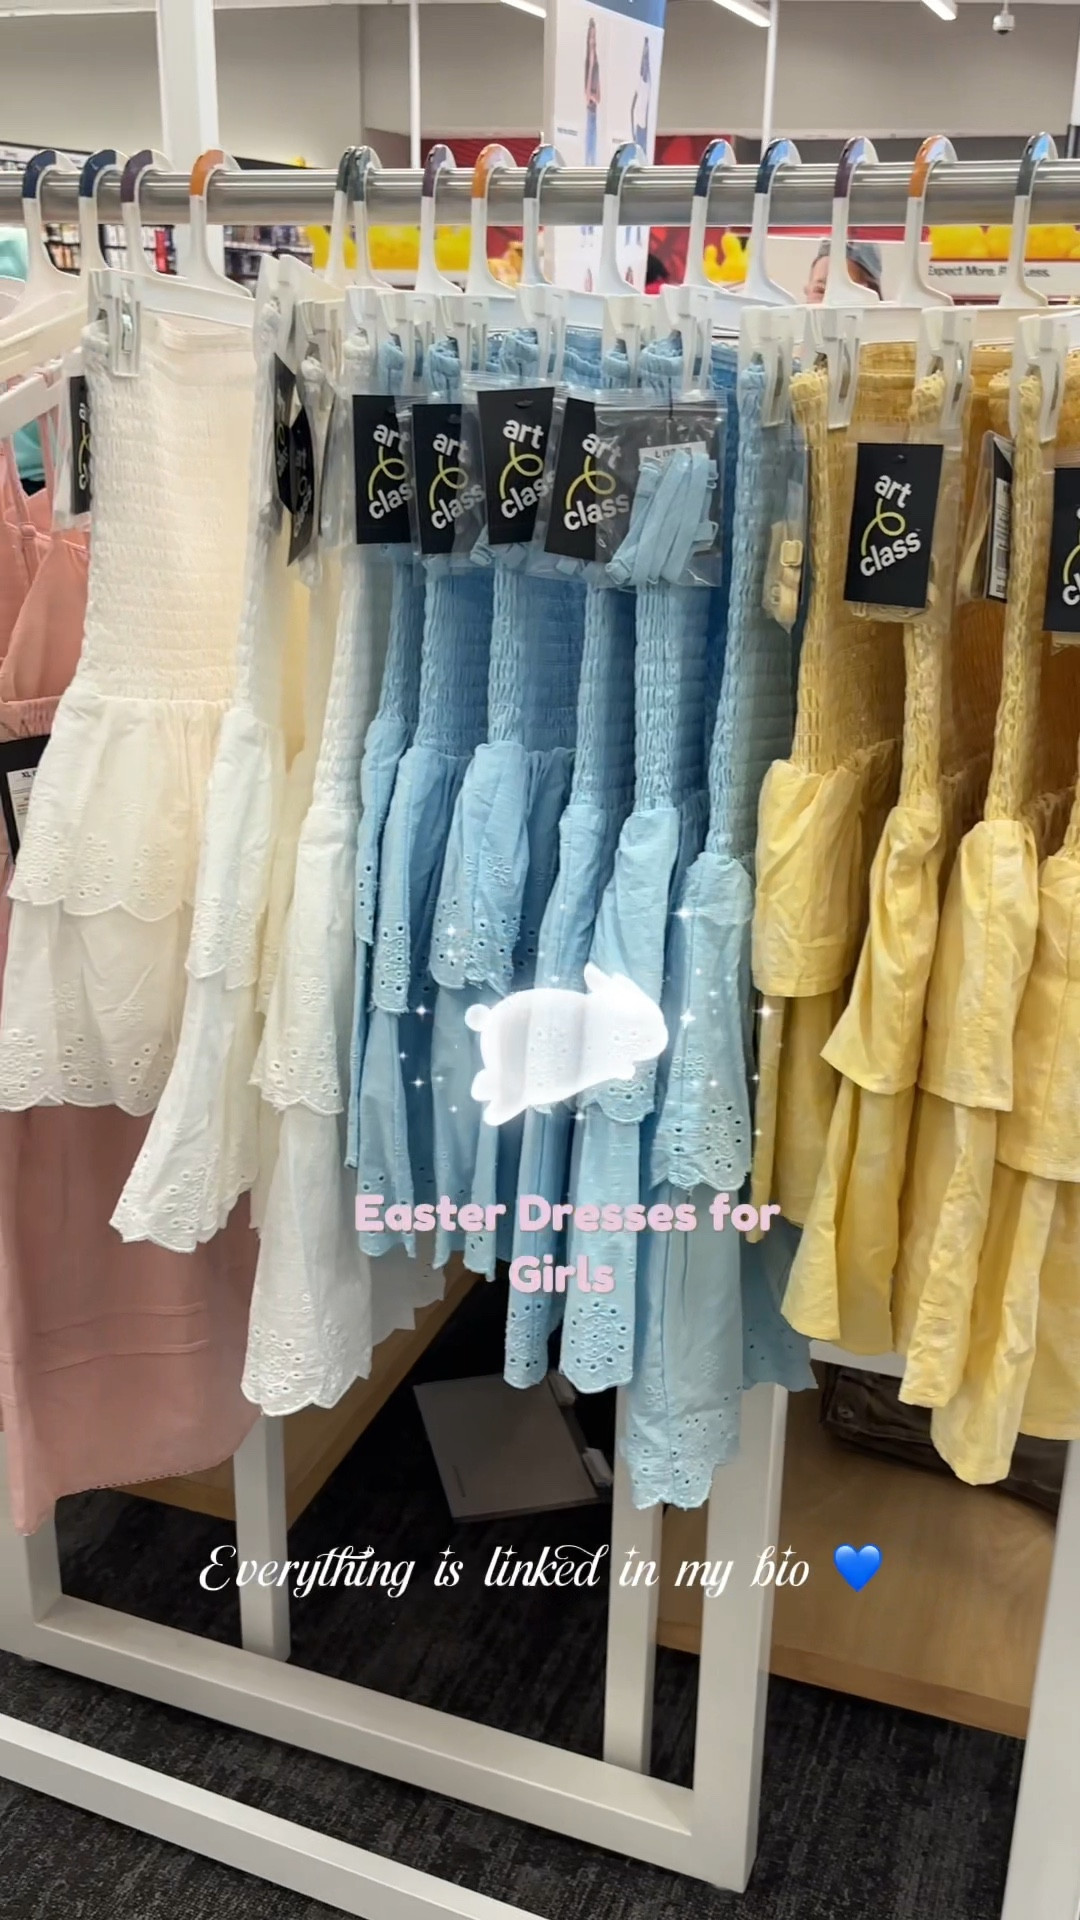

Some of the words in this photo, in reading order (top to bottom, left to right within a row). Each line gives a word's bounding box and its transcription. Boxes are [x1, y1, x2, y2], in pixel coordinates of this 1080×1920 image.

[928, 266, 962, 277] Expect
[373, 424, 410, 454] art
[433, 433, 469, 463] art
[503, 419, 544, 449] art
[582, 433, 621, 469] art
[369, 483, 413, 519] clas
[431, 484, 486, 529] class
[874, 474, 912, 508] art
[564, 494, 629, 530] class
[860, 531, 921, 576] class
